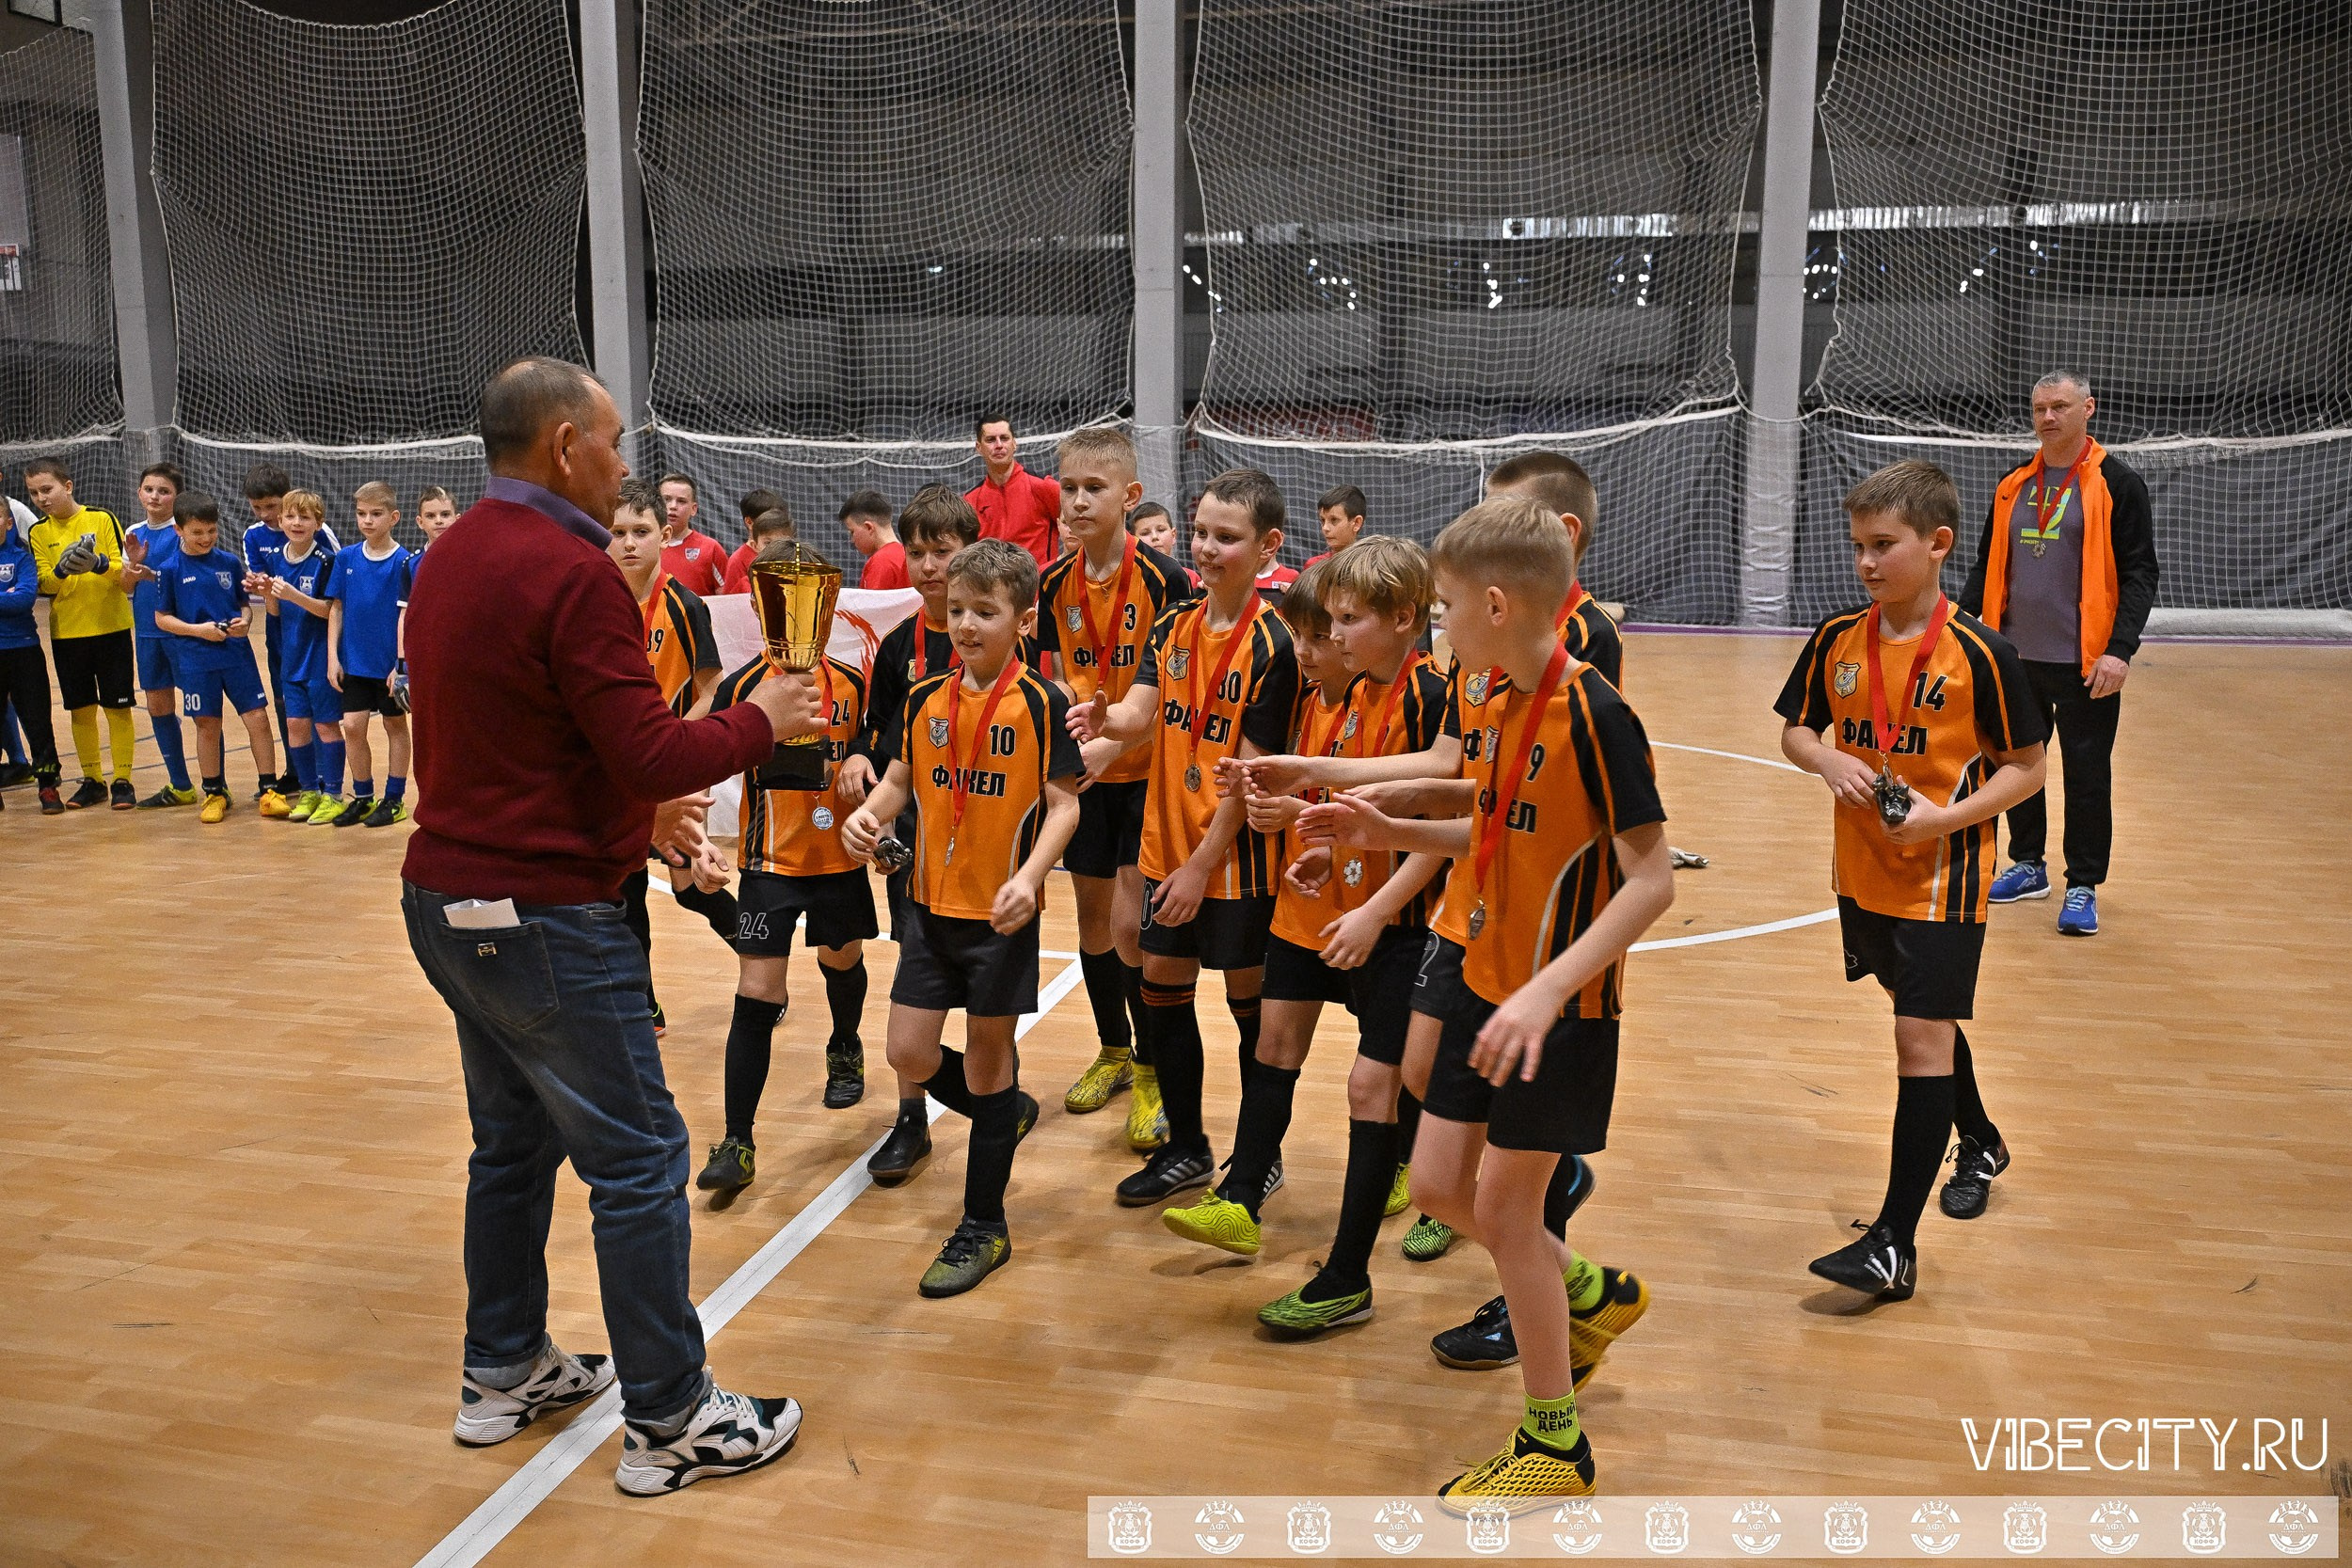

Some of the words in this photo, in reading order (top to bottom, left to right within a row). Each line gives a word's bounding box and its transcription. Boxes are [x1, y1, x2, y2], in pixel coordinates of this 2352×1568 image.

[1123, 602, 1137, 632] 3
[1073, 643, 1136, 669] ФЕЛ
[184, 693, 201, 711] 30
[1913, 671, 1949, 712] 14
[830, 698, 851, 728] 24
[1165, 698, 1232, 746] ФАЕЛ
[989, 723, 1017, 758] 10
[1842, 716, 1929, 756] ФАЕЛ
[1525, 742, 1547, 783] 9
[1478, 786, 1538, 835] ФЕЛ
[739, 911, 770, 940] 24
[1529, 1402, 1576, 1421] НОВЫЙ
[1537, 1418, 1574, 1433] ДЕНЬ
